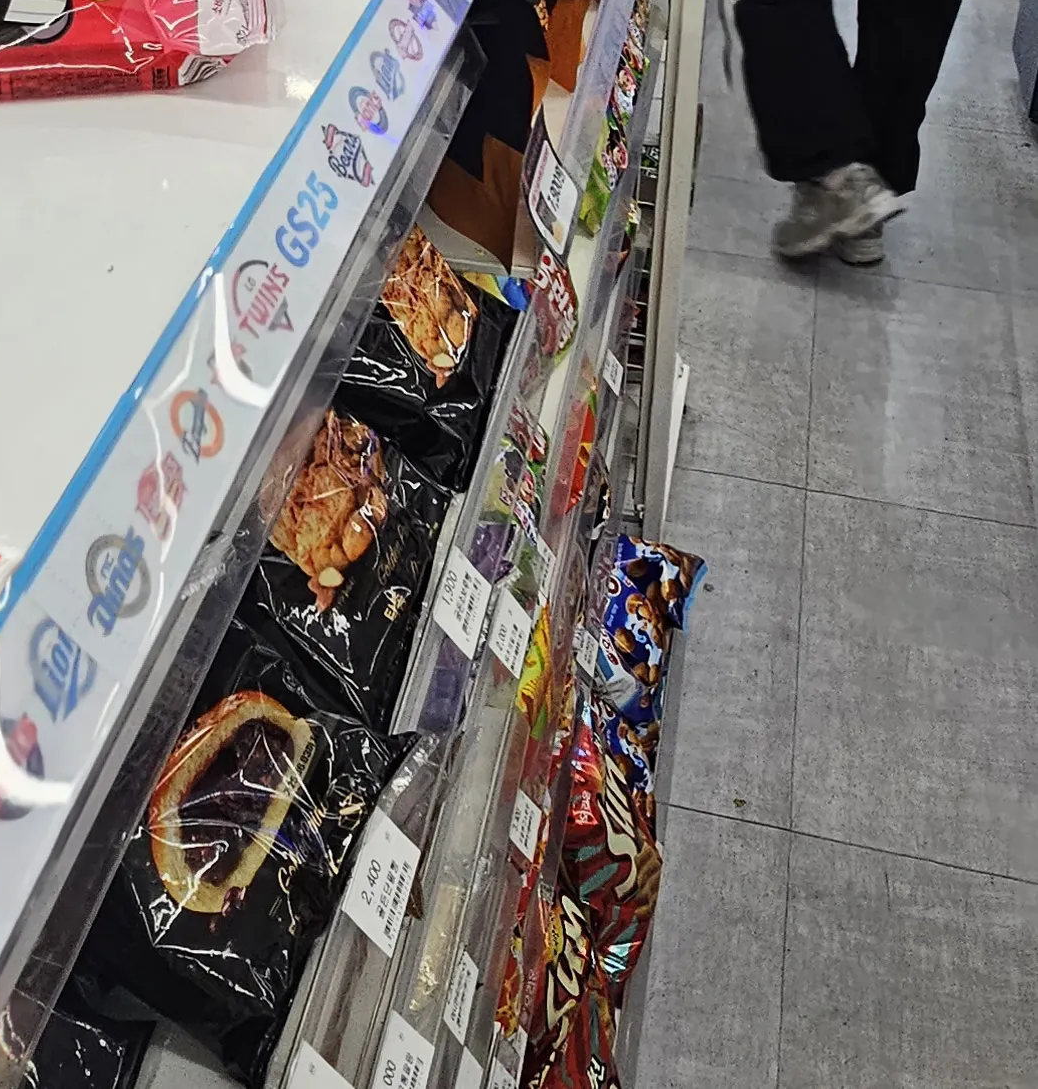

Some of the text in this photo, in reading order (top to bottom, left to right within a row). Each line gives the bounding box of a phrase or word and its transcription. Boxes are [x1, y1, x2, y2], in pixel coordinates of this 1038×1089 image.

[276, 170, 339, 268] GS25
[239, 262, 290, 340] TWINS
[87, 525, 146, 638] Dinos
[438, 571, 463, 606] 1,900
[356, 860, 386, 906] 2,400
